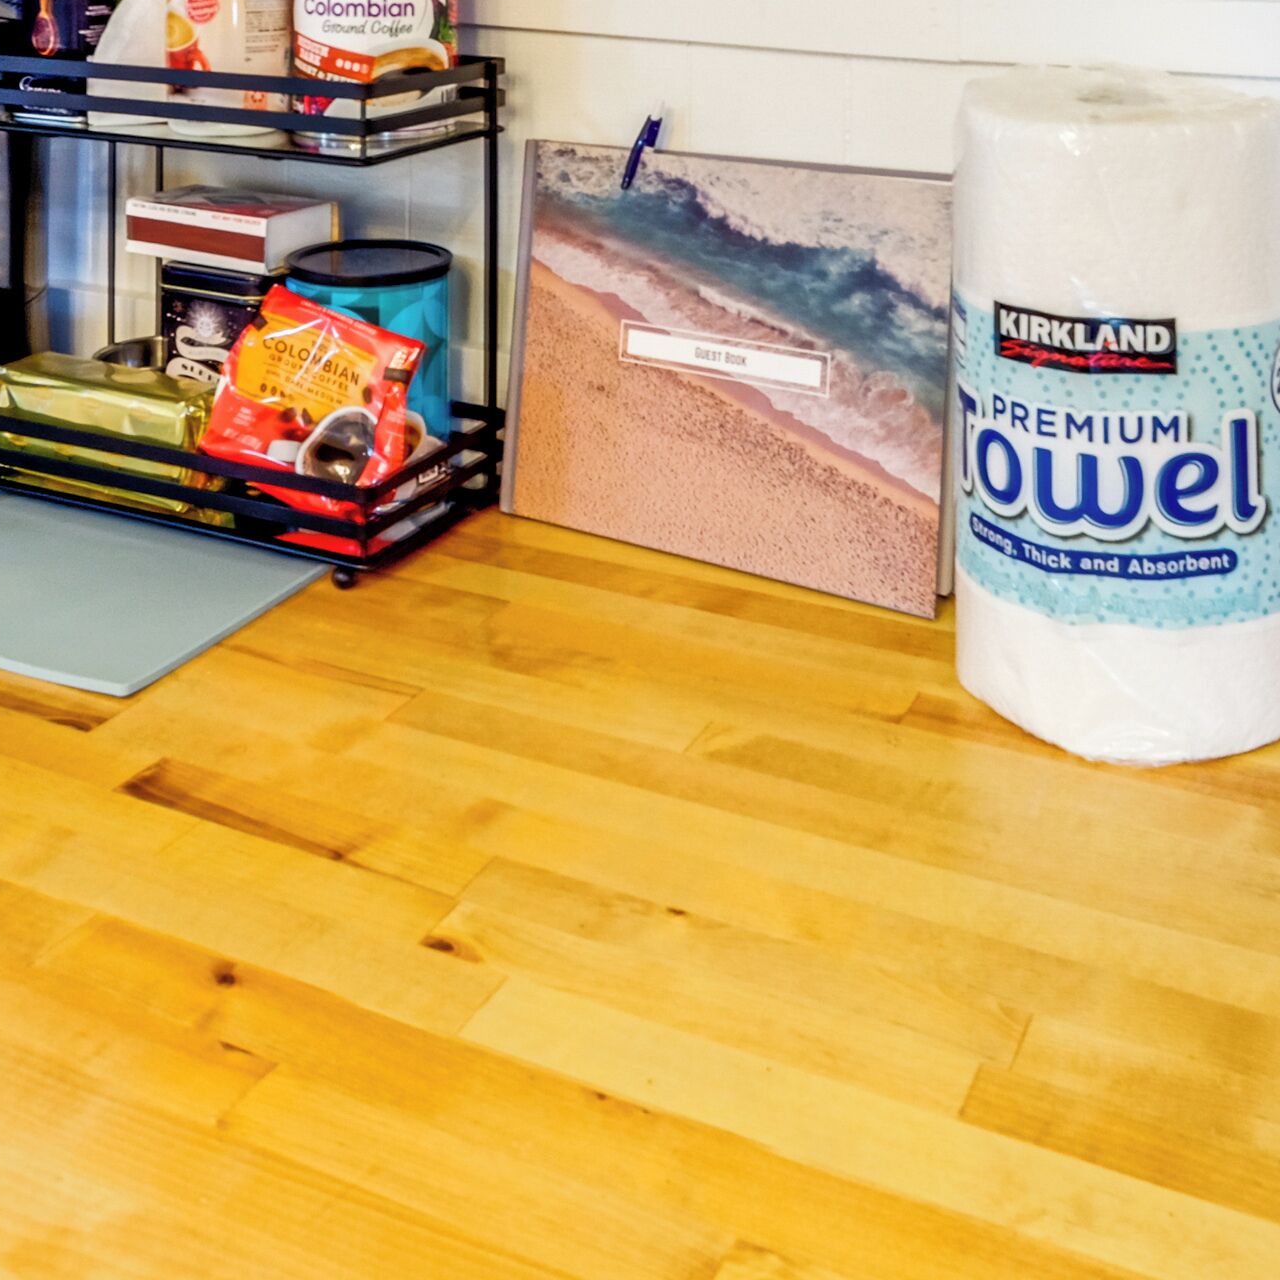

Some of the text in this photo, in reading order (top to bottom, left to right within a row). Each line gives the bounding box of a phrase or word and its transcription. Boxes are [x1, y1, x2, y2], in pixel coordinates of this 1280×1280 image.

[321, 19, 414, 38] Ground Coffee
[999, 307, 1171, 354] KIRKLAND
[694, 346, 748, 367] GUEST BOOK
[992, 393, 1181, 444] PREMIUM
[957, 384, 1259, 530] Towel
[971, 515, 1231, 576] Strong, Thick and Absorbent
